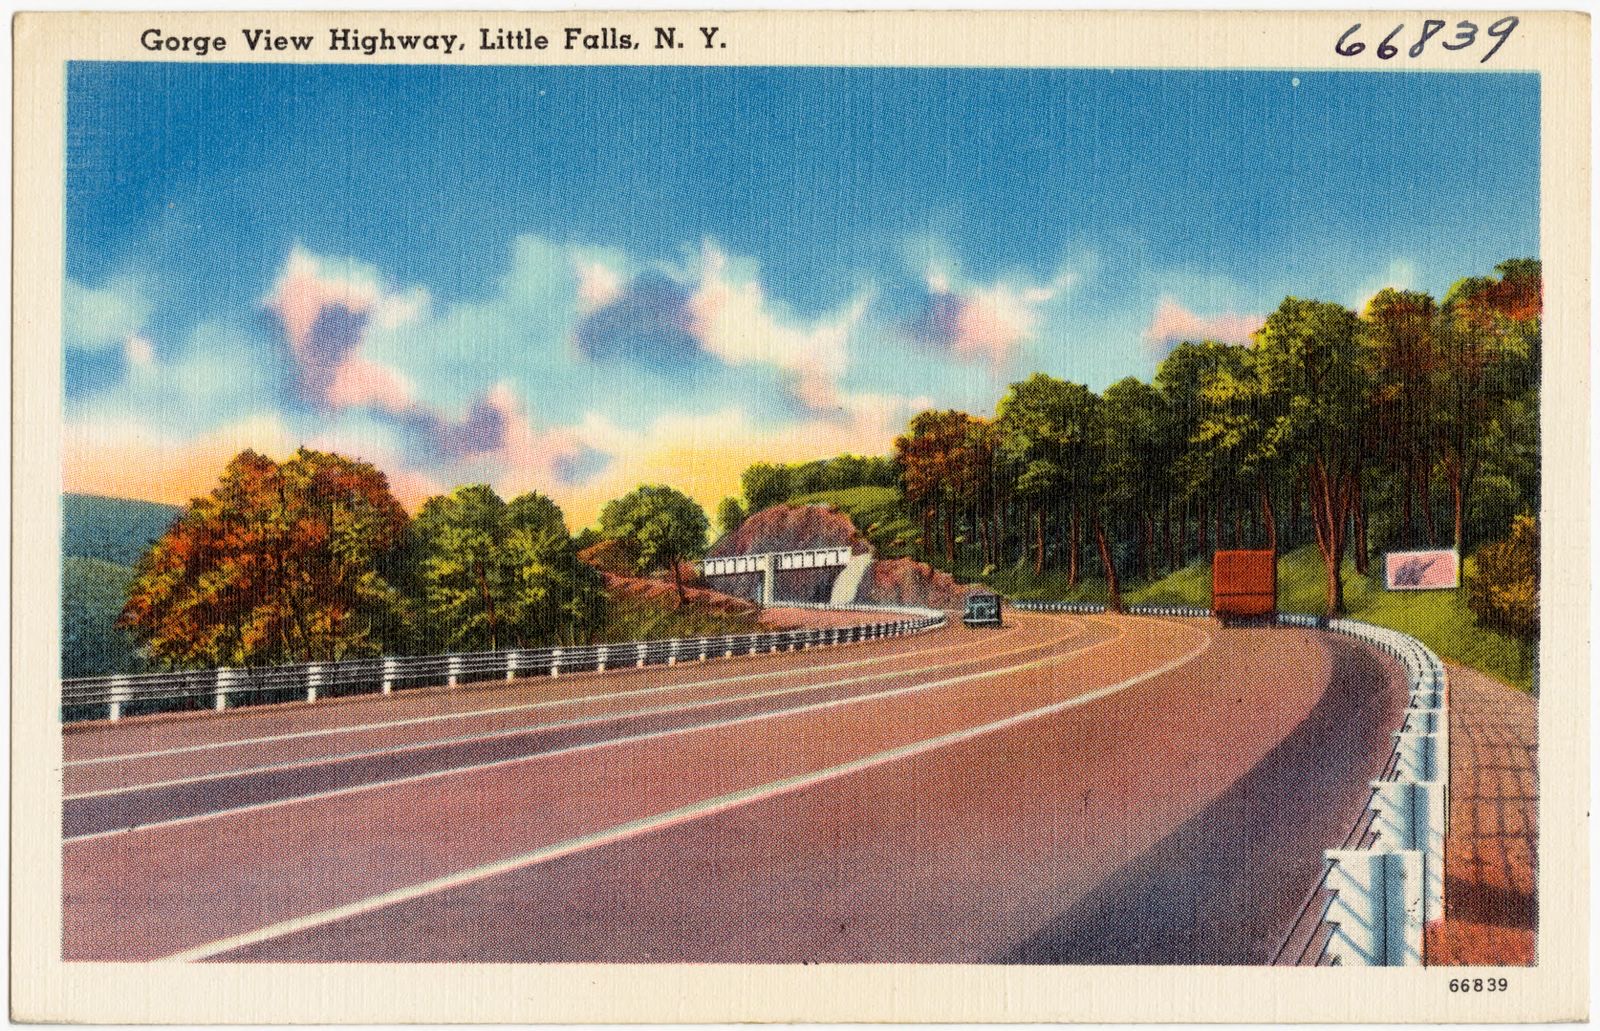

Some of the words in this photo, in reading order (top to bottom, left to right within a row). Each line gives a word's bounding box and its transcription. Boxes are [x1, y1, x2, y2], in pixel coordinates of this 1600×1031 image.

[141, 28, 227, 56] Gorge
[243, 28, 313, 51] View
[330, 28, 465, 56] Highway,
[479, 28, 549, 50] Little
[565, 27, 640, 55] Falls,
[654, 27, 684, 49] N.
[699, 26, 727, 49] Y.
[1335, 16, 1519, 64] 66839
[1449, 978, 1508, 993] 66839
